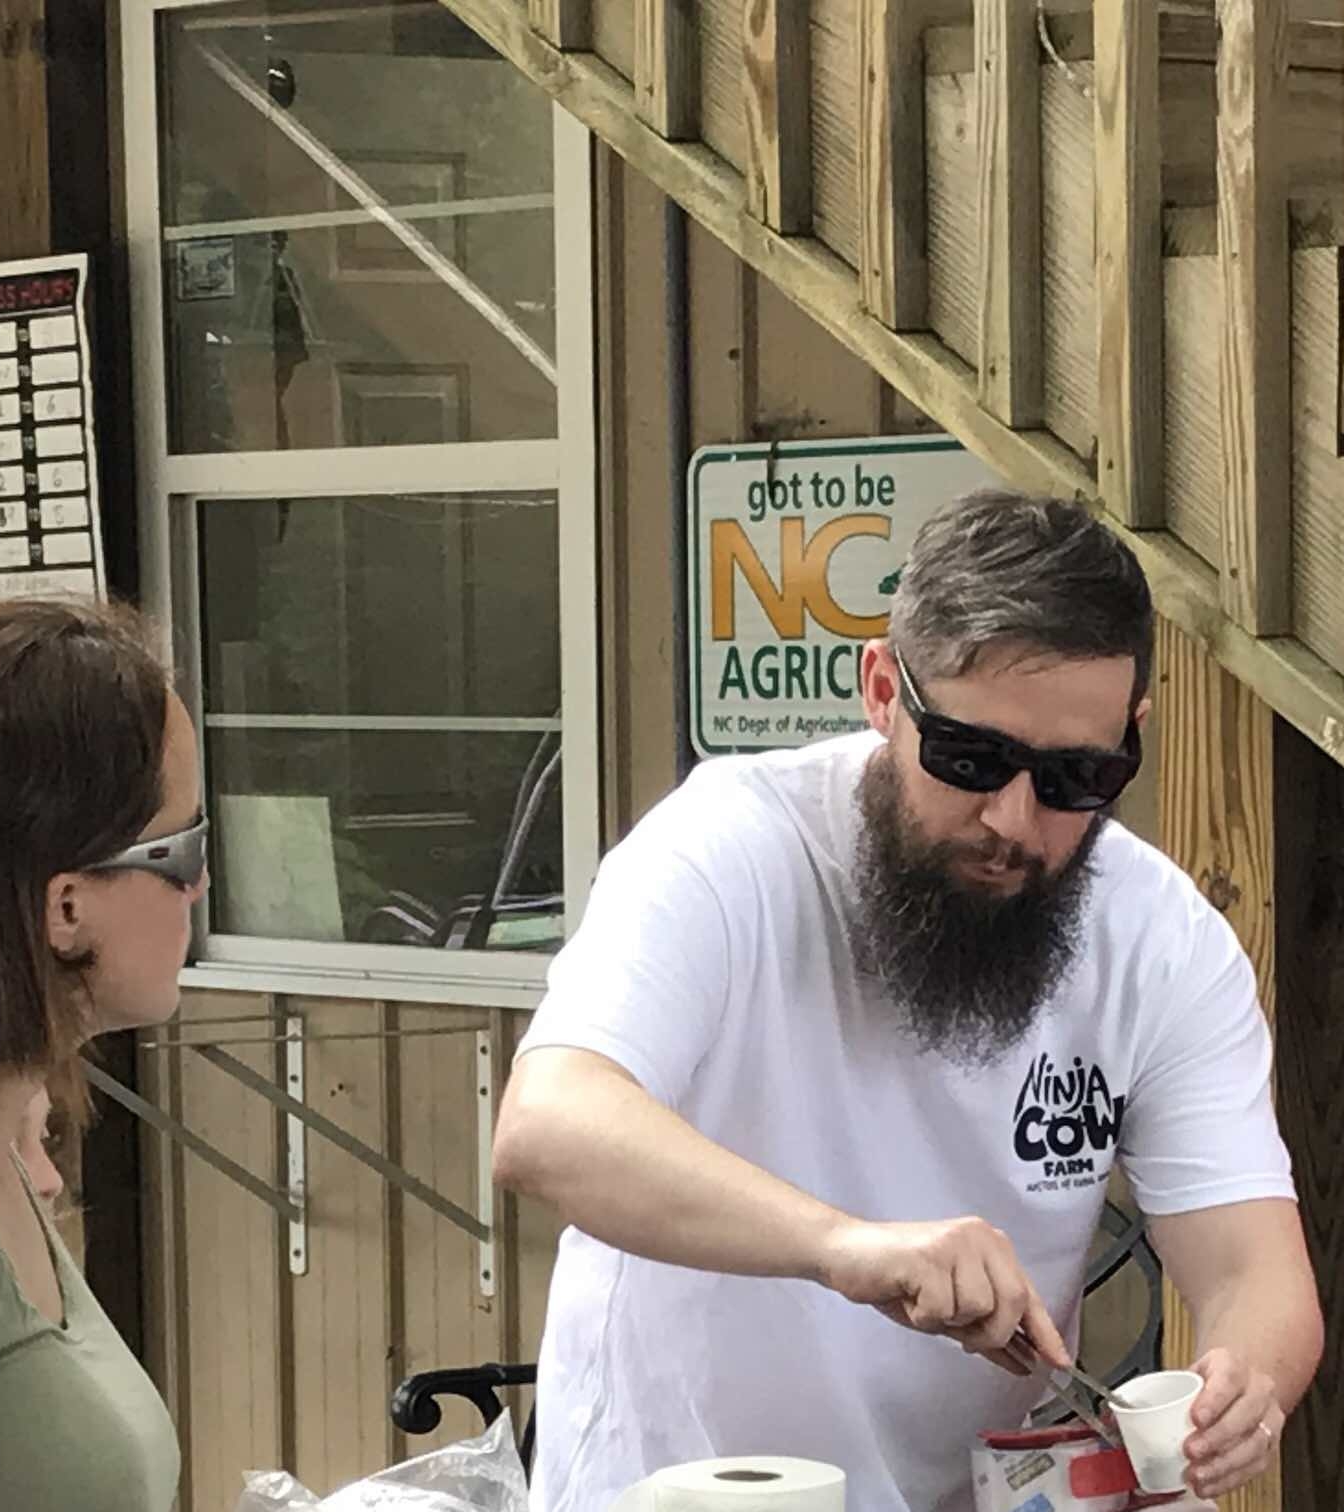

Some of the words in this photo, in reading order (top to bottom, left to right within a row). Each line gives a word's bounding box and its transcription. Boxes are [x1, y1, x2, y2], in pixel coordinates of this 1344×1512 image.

[748, 472, 802, 522] got
[810, 471, 846, 508] to
[855, 464, 896, 507] be
[710, 512, 892, 642] NC
[713, 715, 734, 733] NC
[738, 715, 771, 737] Dept
[775, 715, 791, 733] of
[1014, 1094, 1126, 1162] COW
[1043, 1158, 1094, 1177] FARM
